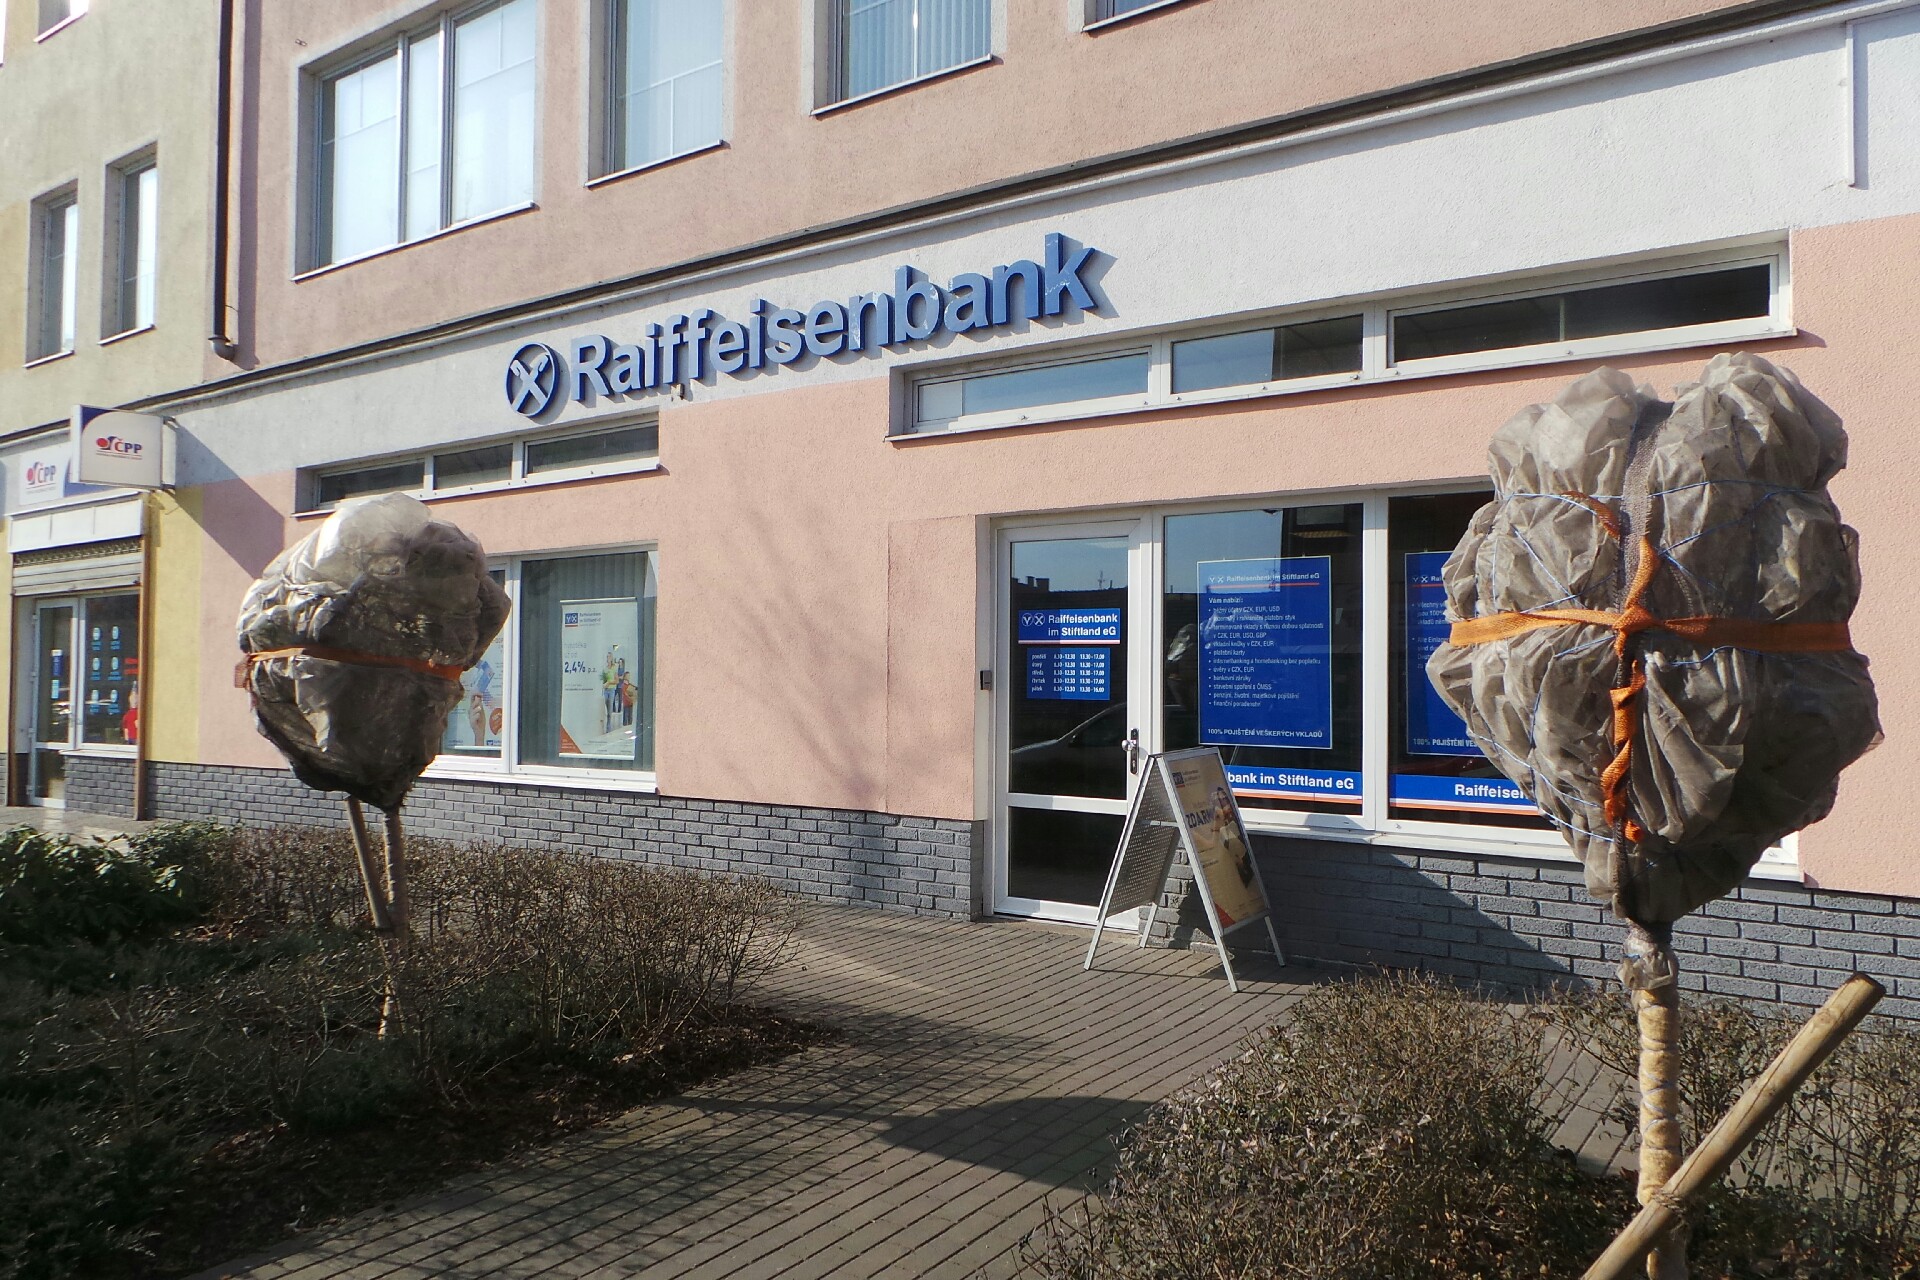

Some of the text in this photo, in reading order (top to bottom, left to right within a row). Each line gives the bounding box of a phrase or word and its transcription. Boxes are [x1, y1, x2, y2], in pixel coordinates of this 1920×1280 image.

[570, 232, 1099, 403] Raiffeisenbank
[114, 438, 142, 454] ČPP
[38, 462, 56, 483] ČPP
[1048, 613, 1118, 624] Raiffeisenbank
[1048, 626, 1117, 637] im Stiftland eG
[564, 661, 586, 674] 2,4%
[1259, 773, 1275, 785] im
[1278, 774, 1332, 788] Stiftland
[1335, 777, 1355, 790] eG
